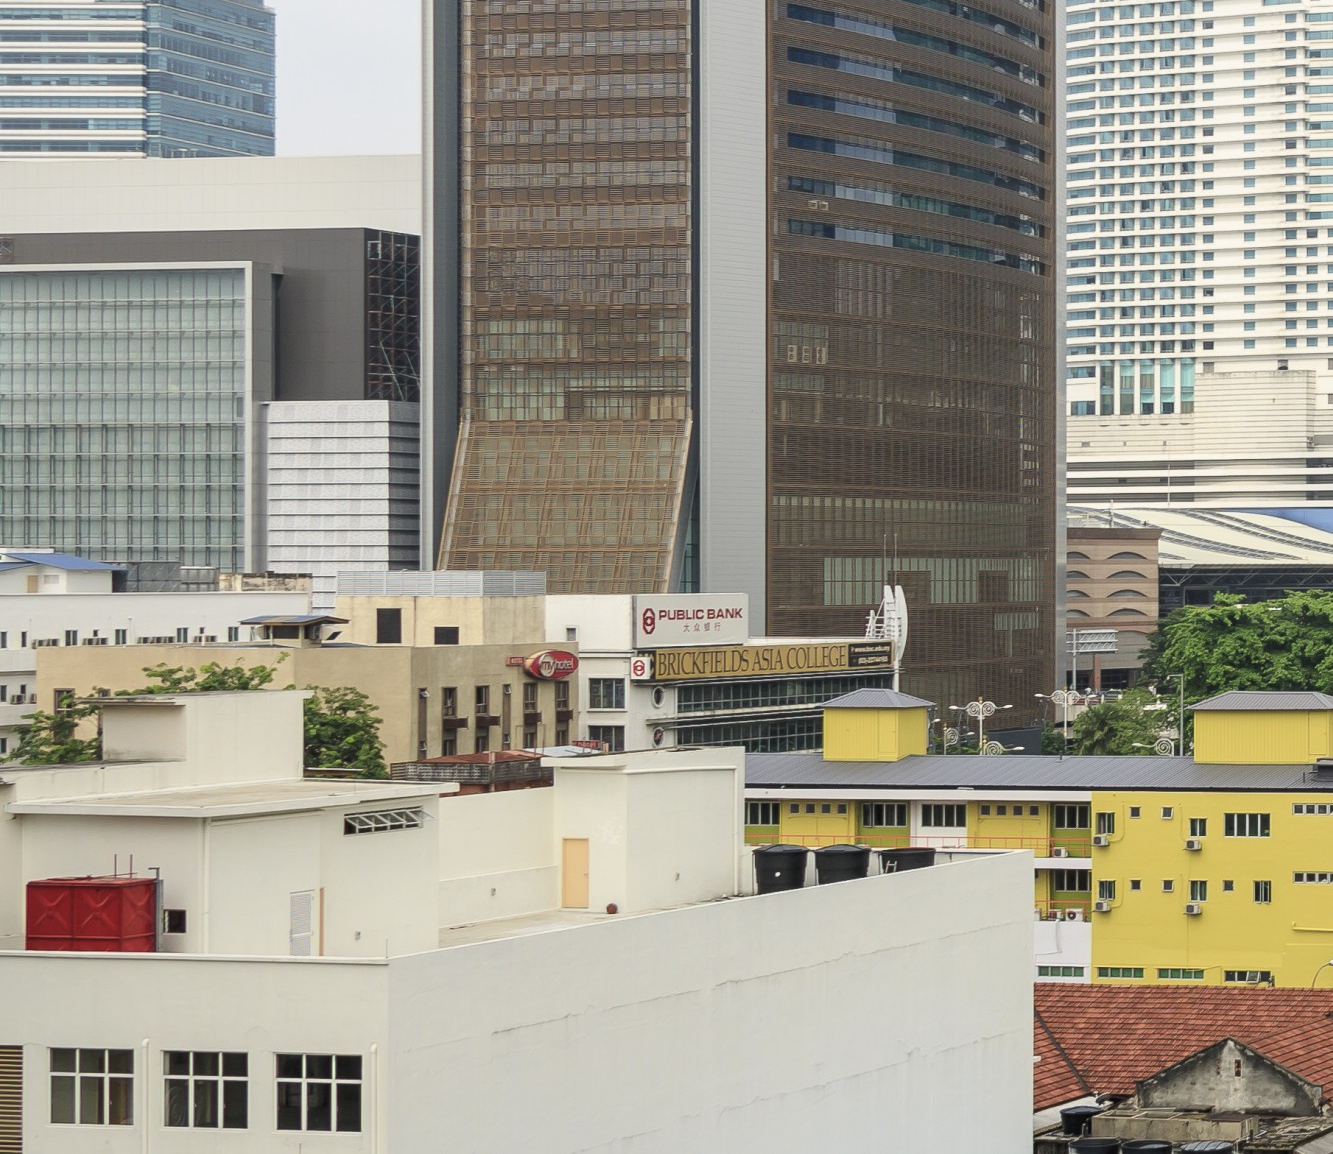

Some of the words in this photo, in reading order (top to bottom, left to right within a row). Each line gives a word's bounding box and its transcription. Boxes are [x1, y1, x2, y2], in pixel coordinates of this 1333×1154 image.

[658, 608, 704, 620] PUBLIC
[707, 608, 743, 620] BANK
[657, 649, 749, 676] BRICKFIELDS
[752, 648, 784, 671] ASIA
[787, 646, 846, 669] COLLEGE
